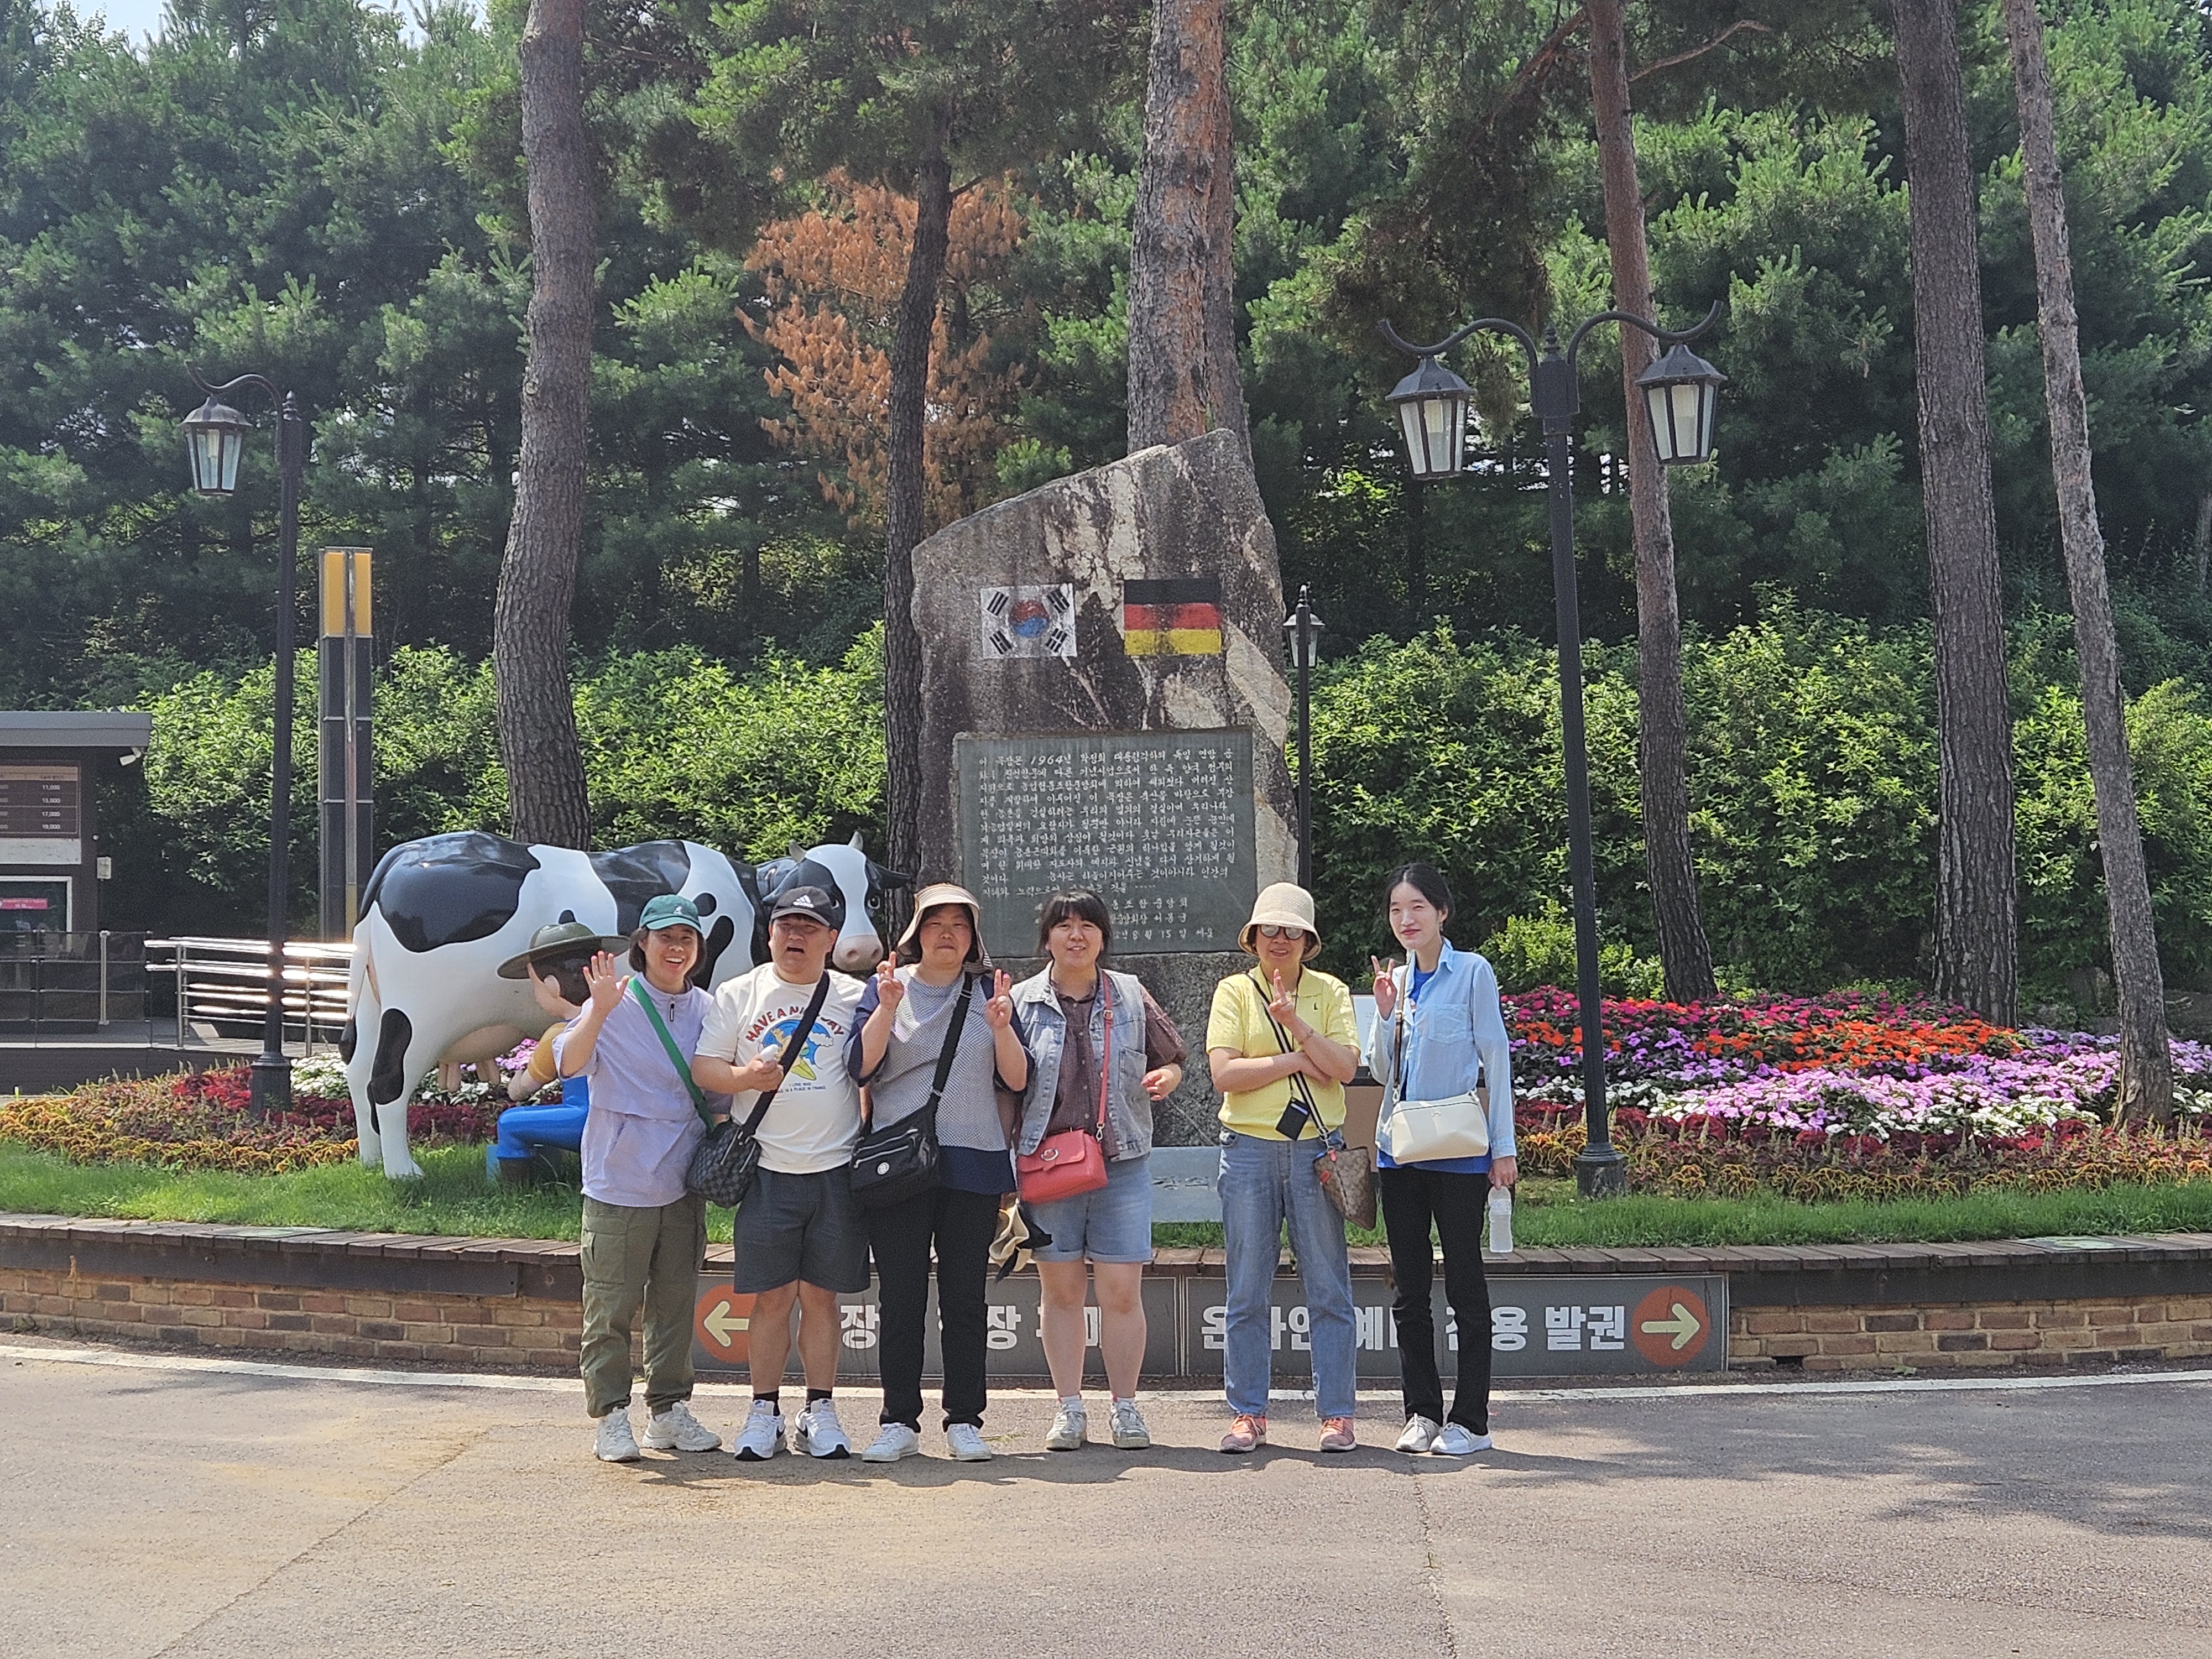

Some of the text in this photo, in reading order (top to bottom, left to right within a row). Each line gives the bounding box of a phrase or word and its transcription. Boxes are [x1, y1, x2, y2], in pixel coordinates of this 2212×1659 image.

[979, 757, 987, 766] 이
[996, 755, 1022, 766] 목장은
[1031, 753, 1071, 765] 1964년
[1080, 752, 1106, 764] 박정희
[1114, 750, 1166, 763] 대통령각하의
[1173, 748, 1191, 760] 독일
[1198, 748, 1216, 760] 연방
[1080, 764, 1140, 777] 기념사업으로서
[1149, 764, 1158, 775] 한
[1182, 762, 1199, 774] 양국
[1208, 760, 1232, 773] 정부의
[978, 782, 1014, 794] 지원으로
[1021, 779, 1107, 792] 농업협동조합중앙회에
[1115, 776, 1140, 789] 의하여
[1224, 774, 1234, 785] 산
[1004, 794, 1038, 805] 개발하여
[1089, 792, 1098, 802] 이
[1106, 791, 1133, 804] 목장은
[1140, 789, 1167, 802] 축산을
[1173, 788, 1210, 800] 바탕으로
[1217, 787, 1234, 799] 부강
[995, 808, 1022, 819] 농촌을
[1030, 806, 1073, 818] 건설하려는
[1080, 804, 1108, 817] 우리의
[1191, 801, 1228, 812] 우리나라
[1115, 816, 1142, 827] 아니라
[1150, 815, 1176, 827] 자립에
[1208, 813, 1235, 825] 농민에
[997, 833, 1025, 845] 의욕과
[1031, 832, 1057, 844] 희망의
[1064, 831, 1091, 844] 상징이
[1225, 826, 1234, 837] 이
[980, 847, 1007, 858] 목장이
[1073, 844, 1100, 855] 이룩한
[1015, 859, 1042, 870] 위대한
[1050, 858, 1083, 868] 지도자의
[1160, 854, 1176, 865] 다시
[982, 873, 1009, 884] 것이다
[1047, 872, 1074, 882] 농사는
[1201, 866, 1228, 878] 인간의
[745, 1011, 775, 1042] HAVE
[778, 1008, 787, 1018] A
[1355, 1306, 1399, 1350] 예
[1545, 1306, 1624, 1350] 발권
